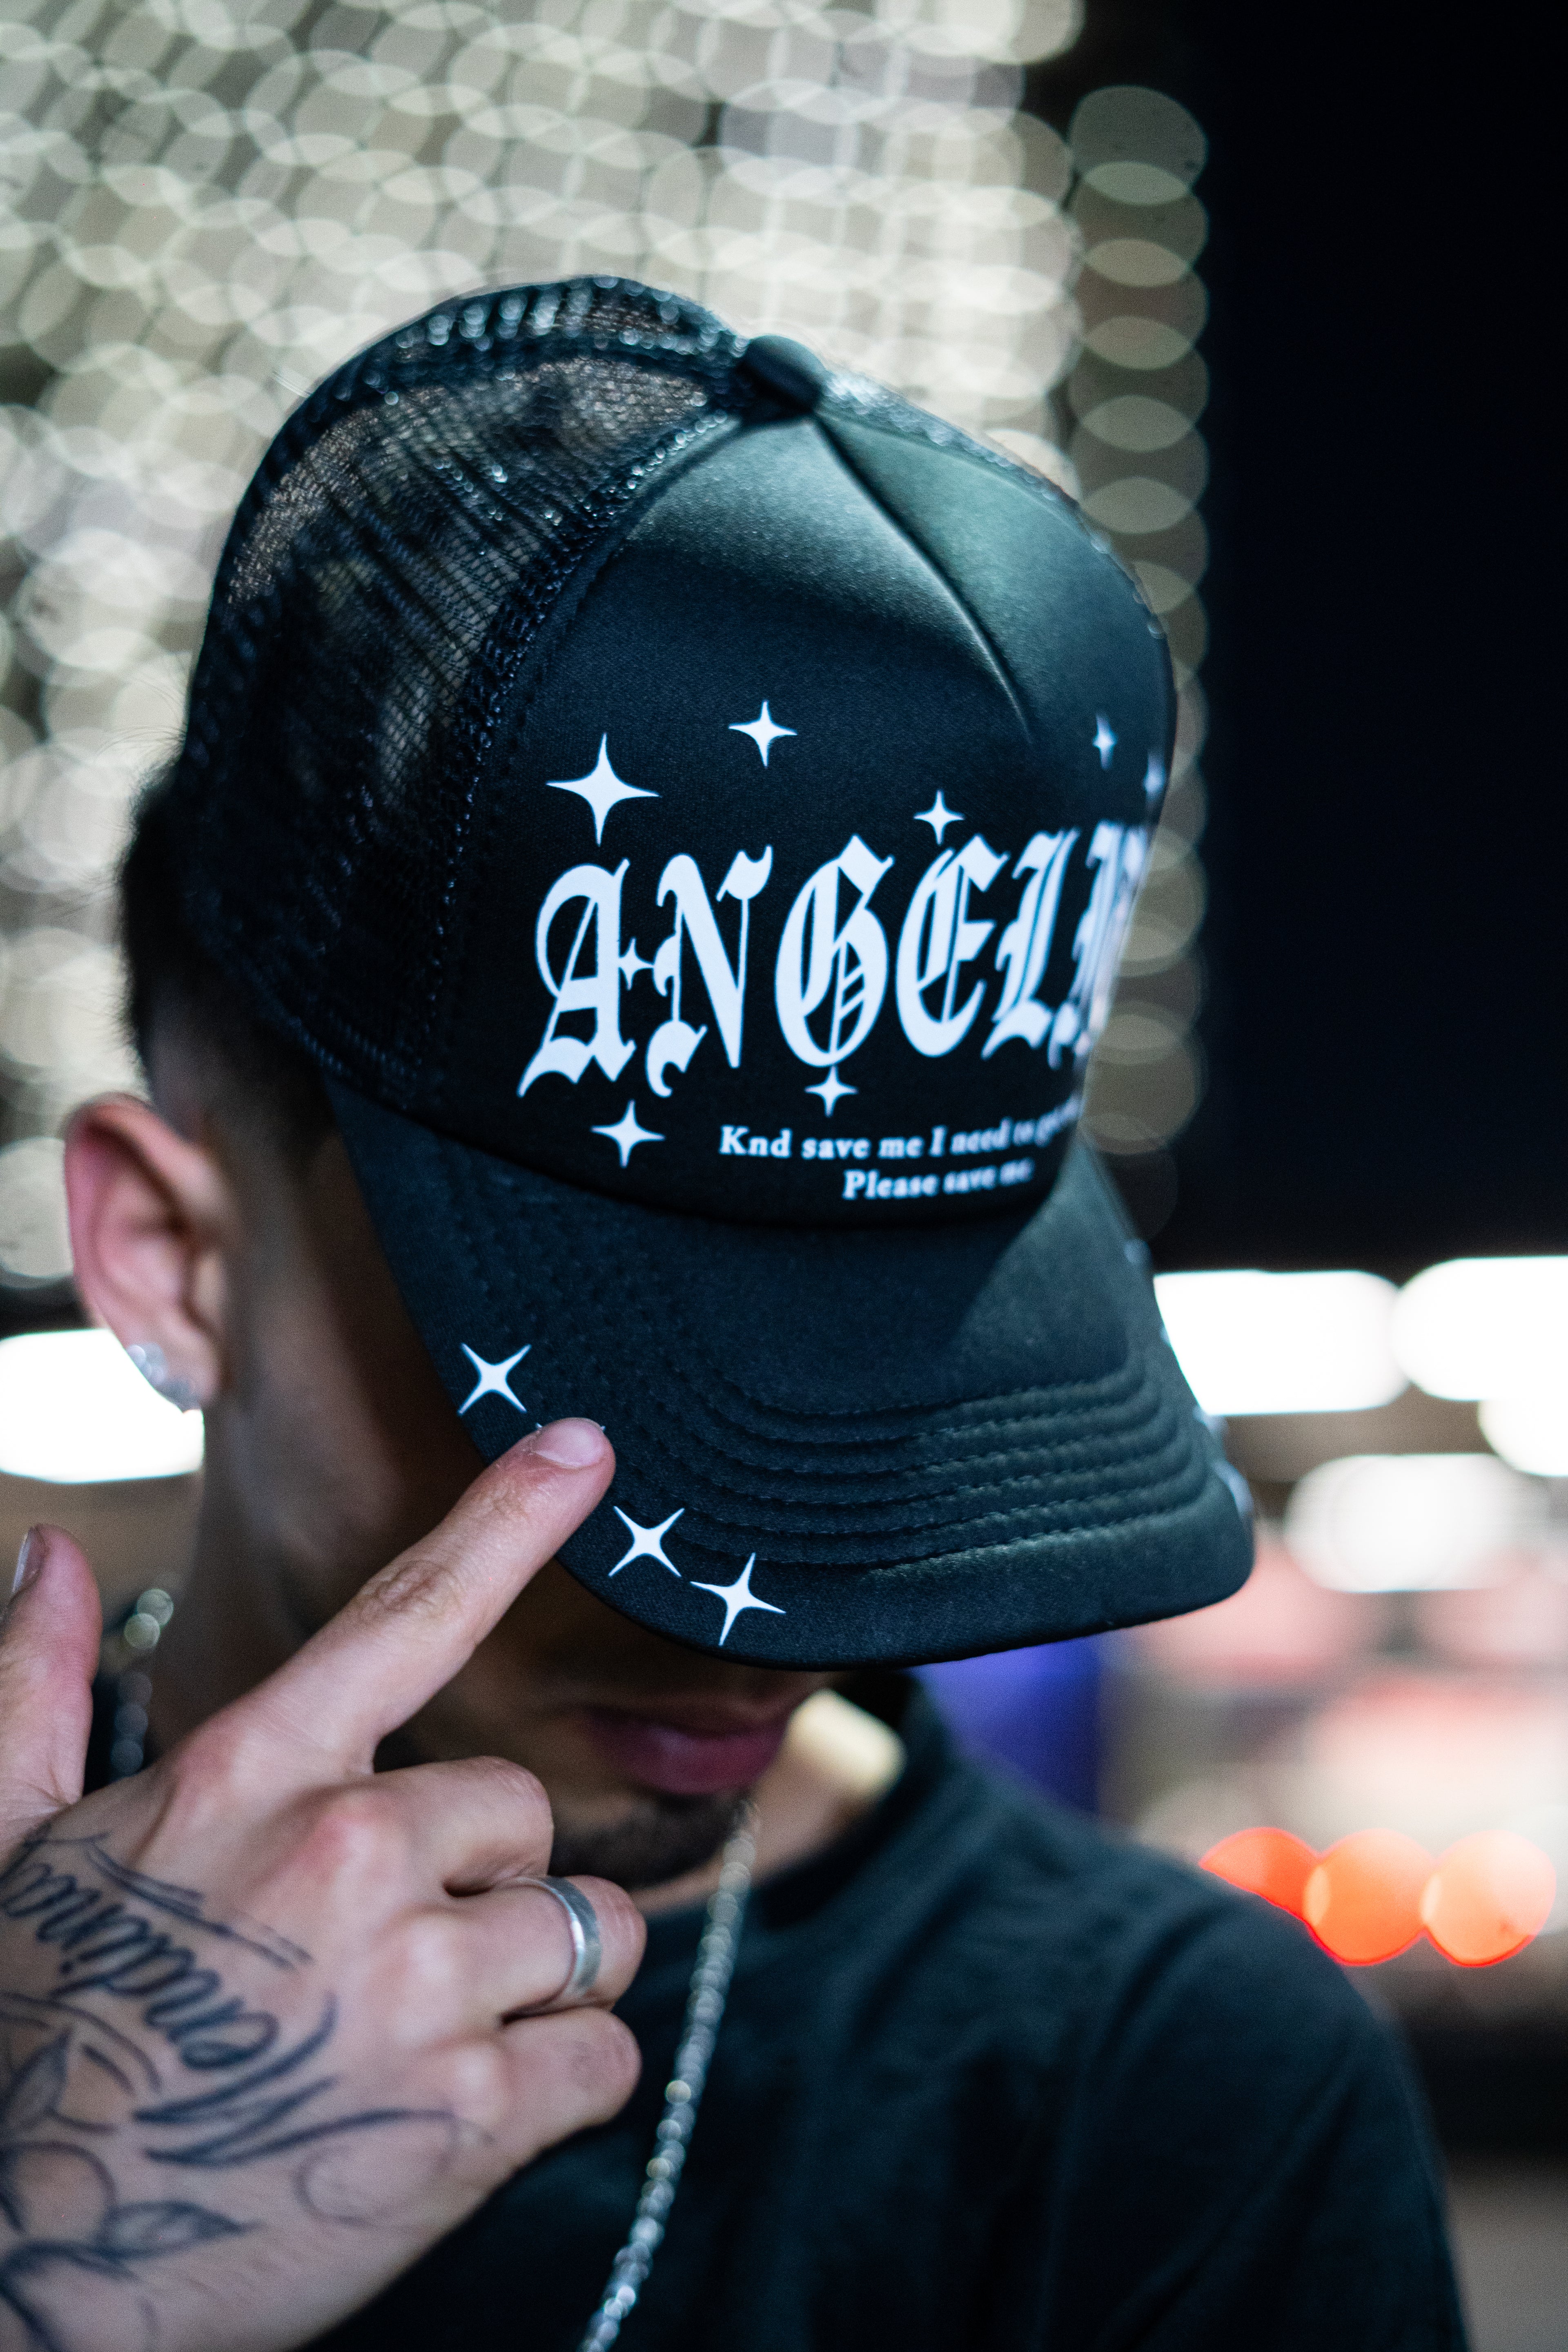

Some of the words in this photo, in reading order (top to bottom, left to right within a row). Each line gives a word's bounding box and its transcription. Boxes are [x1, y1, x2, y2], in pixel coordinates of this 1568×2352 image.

[801, 1138, 871, 1160] save
[878, 1137, 923, 1159] me
[929, 1126, 945, 1156] I
[950, 1119, 1011, 1154] need
[842, 1169, 938, 1200] Please
[943, 1167, 996, 1193] save
